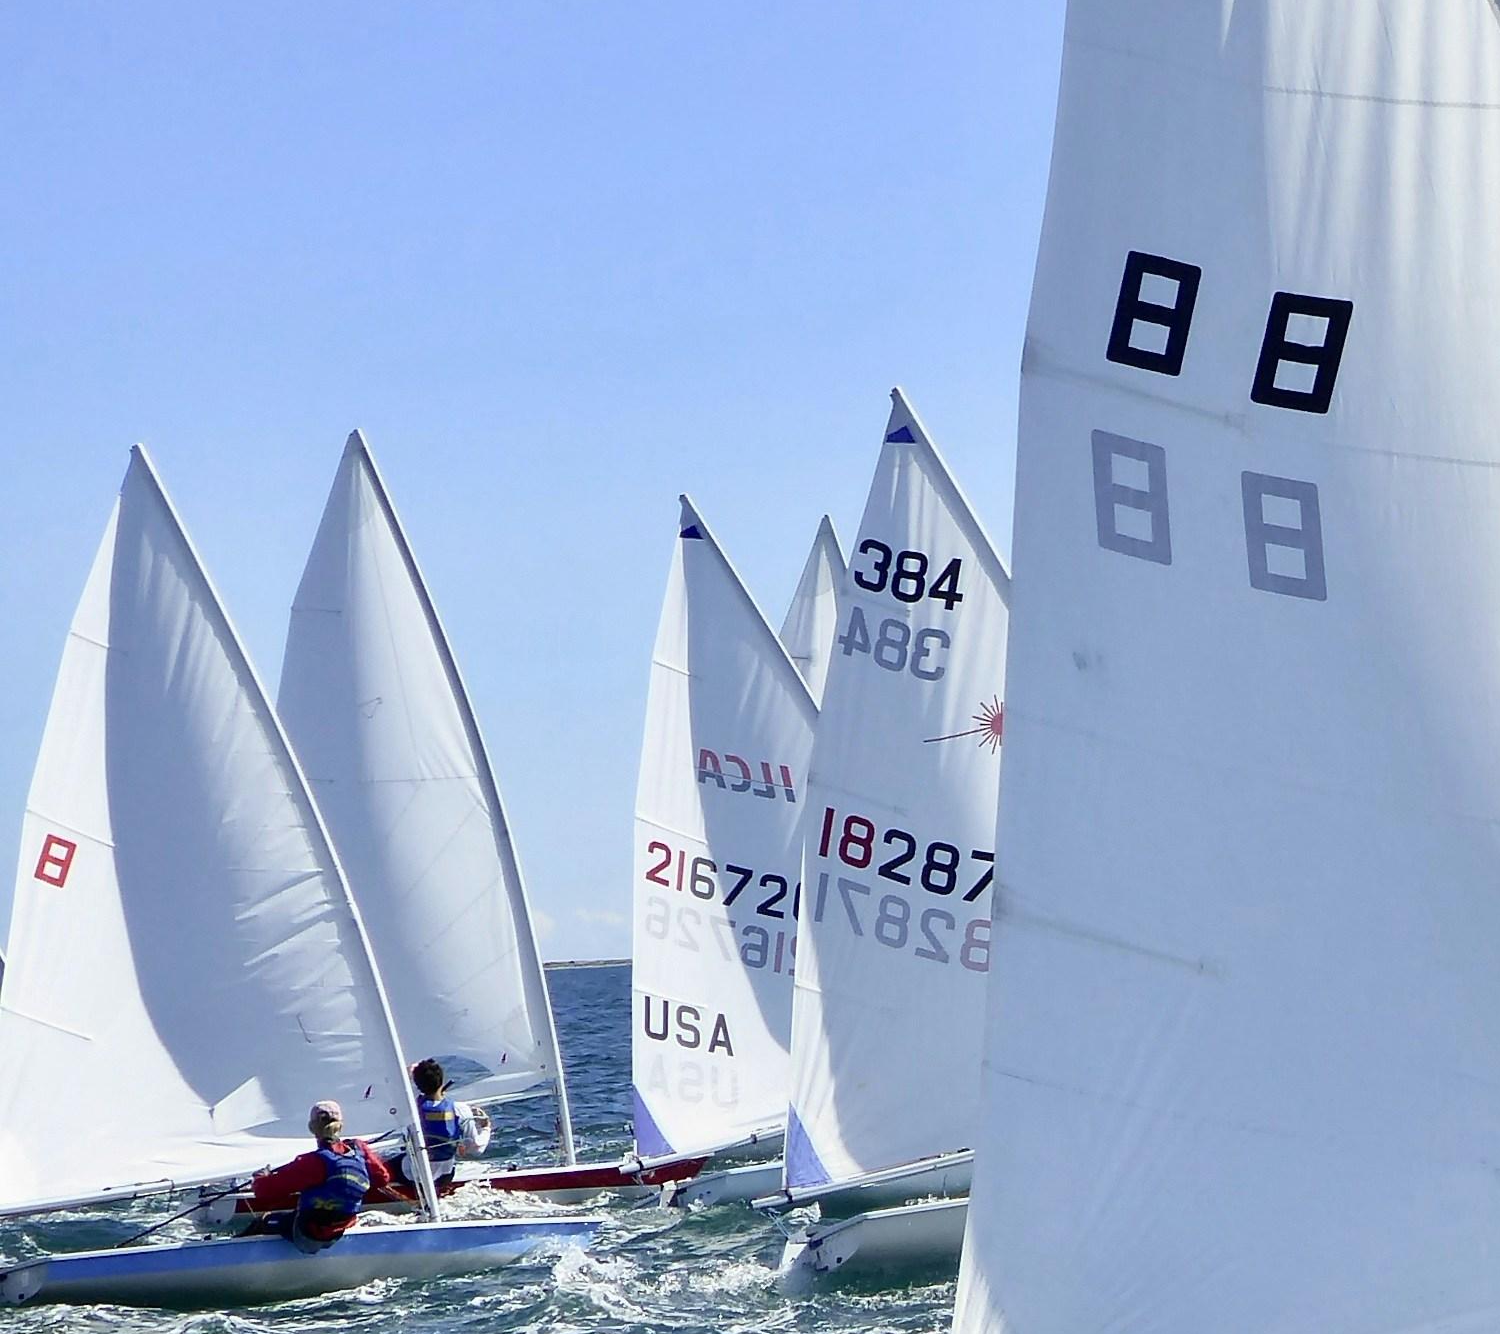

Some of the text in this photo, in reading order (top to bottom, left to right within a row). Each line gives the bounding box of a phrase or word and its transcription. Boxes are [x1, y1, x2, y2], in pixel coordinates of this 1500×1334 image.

[854, 538, 964, 611] 384
[34, 833, 77, 888] 8
[645, 841, 801, 921] 21672
[644, 995, 734, 1057] USA
